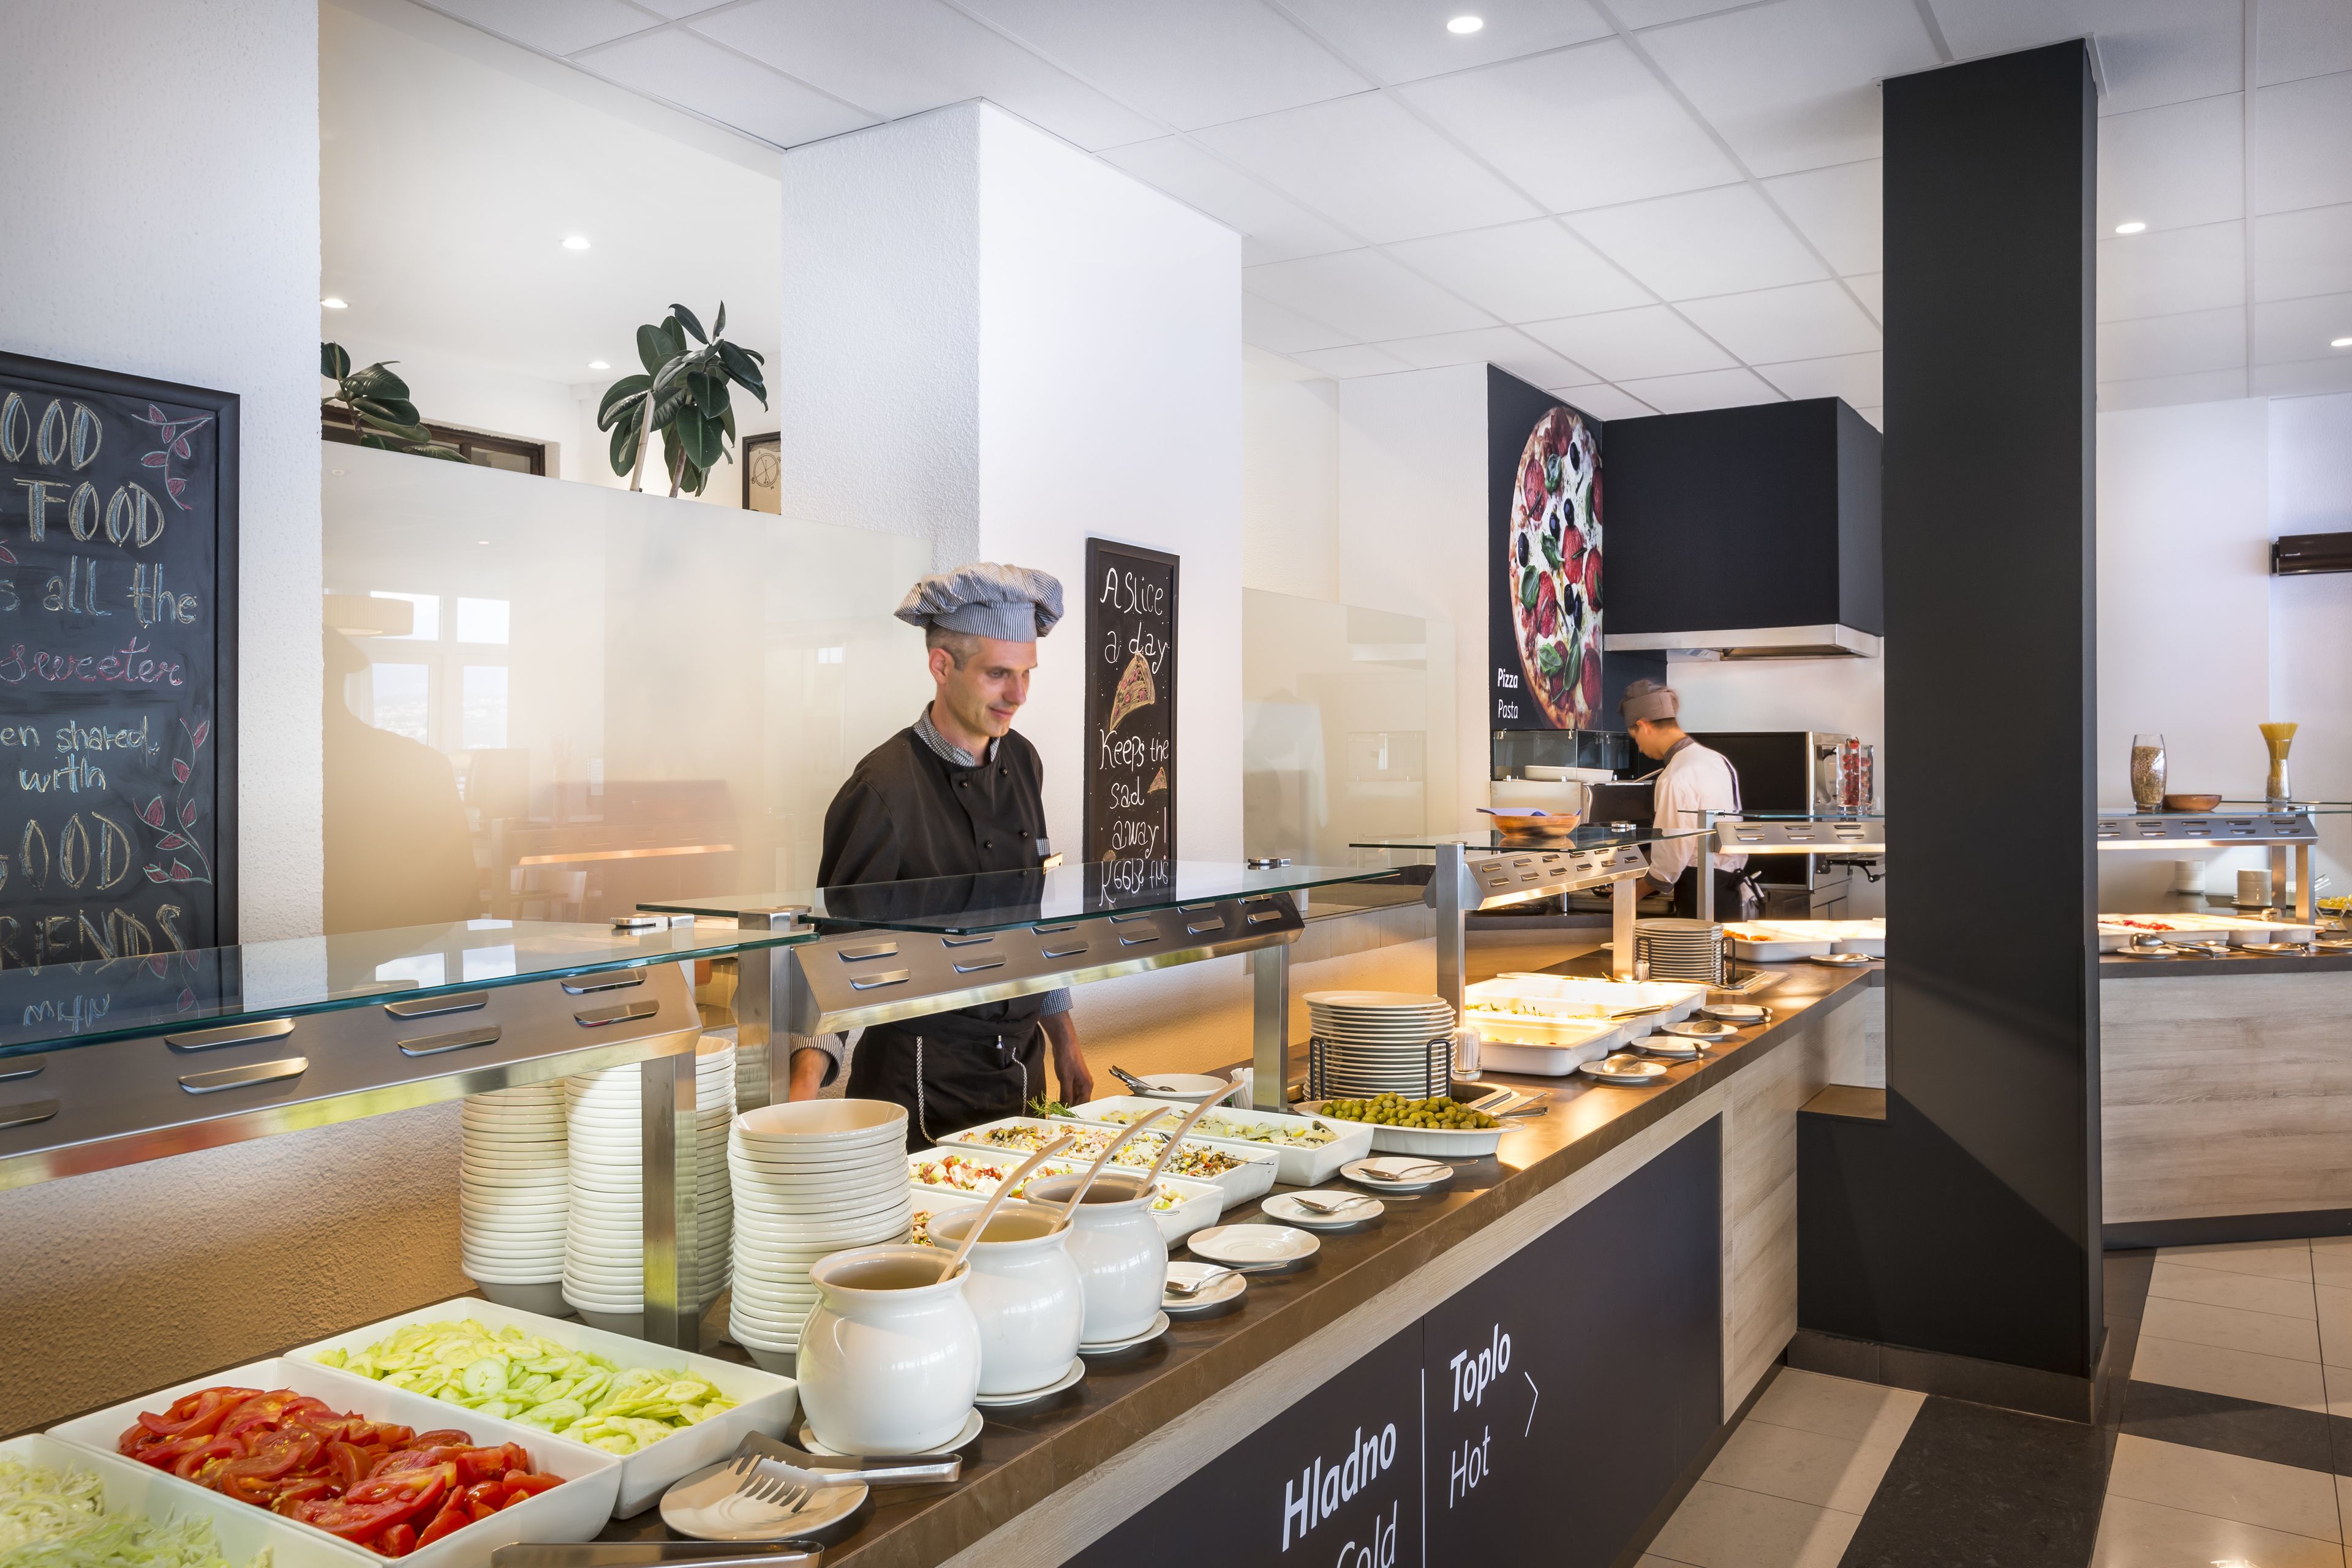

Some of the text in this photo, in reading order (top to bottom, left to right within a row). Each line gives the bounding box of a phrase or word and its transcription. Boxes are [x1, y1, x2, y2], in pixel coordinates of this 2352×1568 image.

[13, 478, 165, 548] FOOD
[43, 555, 112, 616] all
[126, 562, 198, 628] the
[1104, 621, 1169, 674] a day
[1498, 668, 1518, 688] Pizza
[1498, 699, 1518, 719] Pasta
[18, 753, 107, 793] with
[1150, 737, 1169, 762] the
[1109, 775, 1145, 809] sad
[1450, 1323, 1511, 1412] Toplo
[1283, 1423, 1396, 1552] Hladno
[1450, 1425, 1491, 1509] Hot
